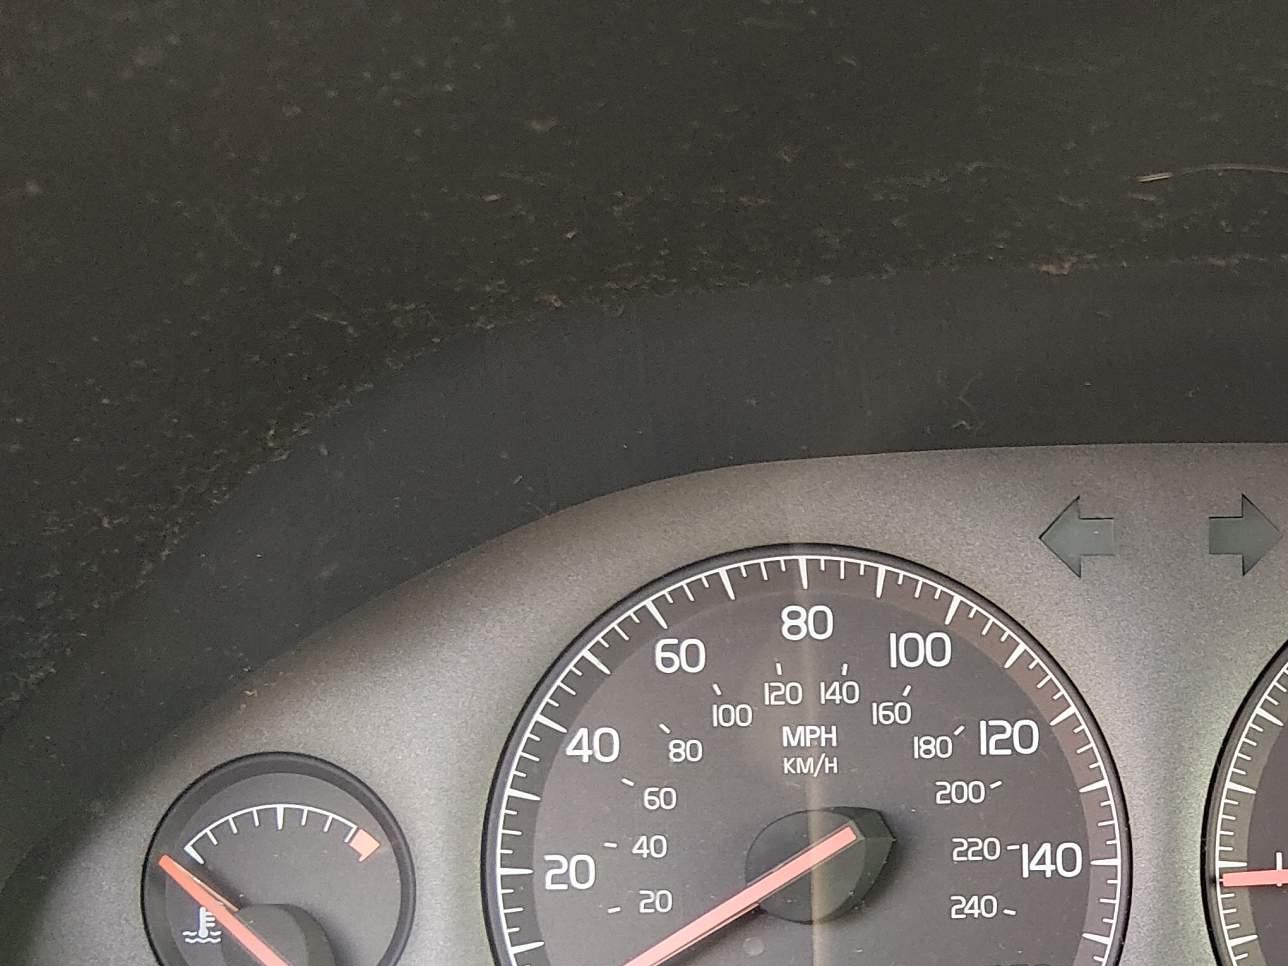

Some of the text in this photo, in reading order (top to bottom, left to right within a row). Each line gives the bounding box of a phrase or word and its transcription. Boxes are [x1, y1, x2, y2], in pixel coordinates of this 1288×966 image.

[781, 605, 833, 640] 80
[655, 638, 705, 673] 60
[889, 633, 951, 668] 100
[765, 683, 802, 705] 120
[820, 682, 860, 704] 140
[712, 704, 752, 726] 100
[872, 703, 911, 725] 160
[566, 728, 620, 763] 40
[783, 726, 837, 748] MPH
[914, 736, 952, 758] 180
[980, 720, 1039, 755] 120
[669, 740, 702, 762] 80
[783, 757, 837, 775] KM/H
[643, 788, 676, 810] 60
[935, 782, 985, 803] 200
[632, 836, 667, 858] 40
[952, 839, 1000, 860] 220
[1021, 842, 1082, 878] 140
[544, 855, 594, 890] 20
[639, 891, 672, 913] 20
[950, 896, 997, 919] 240
